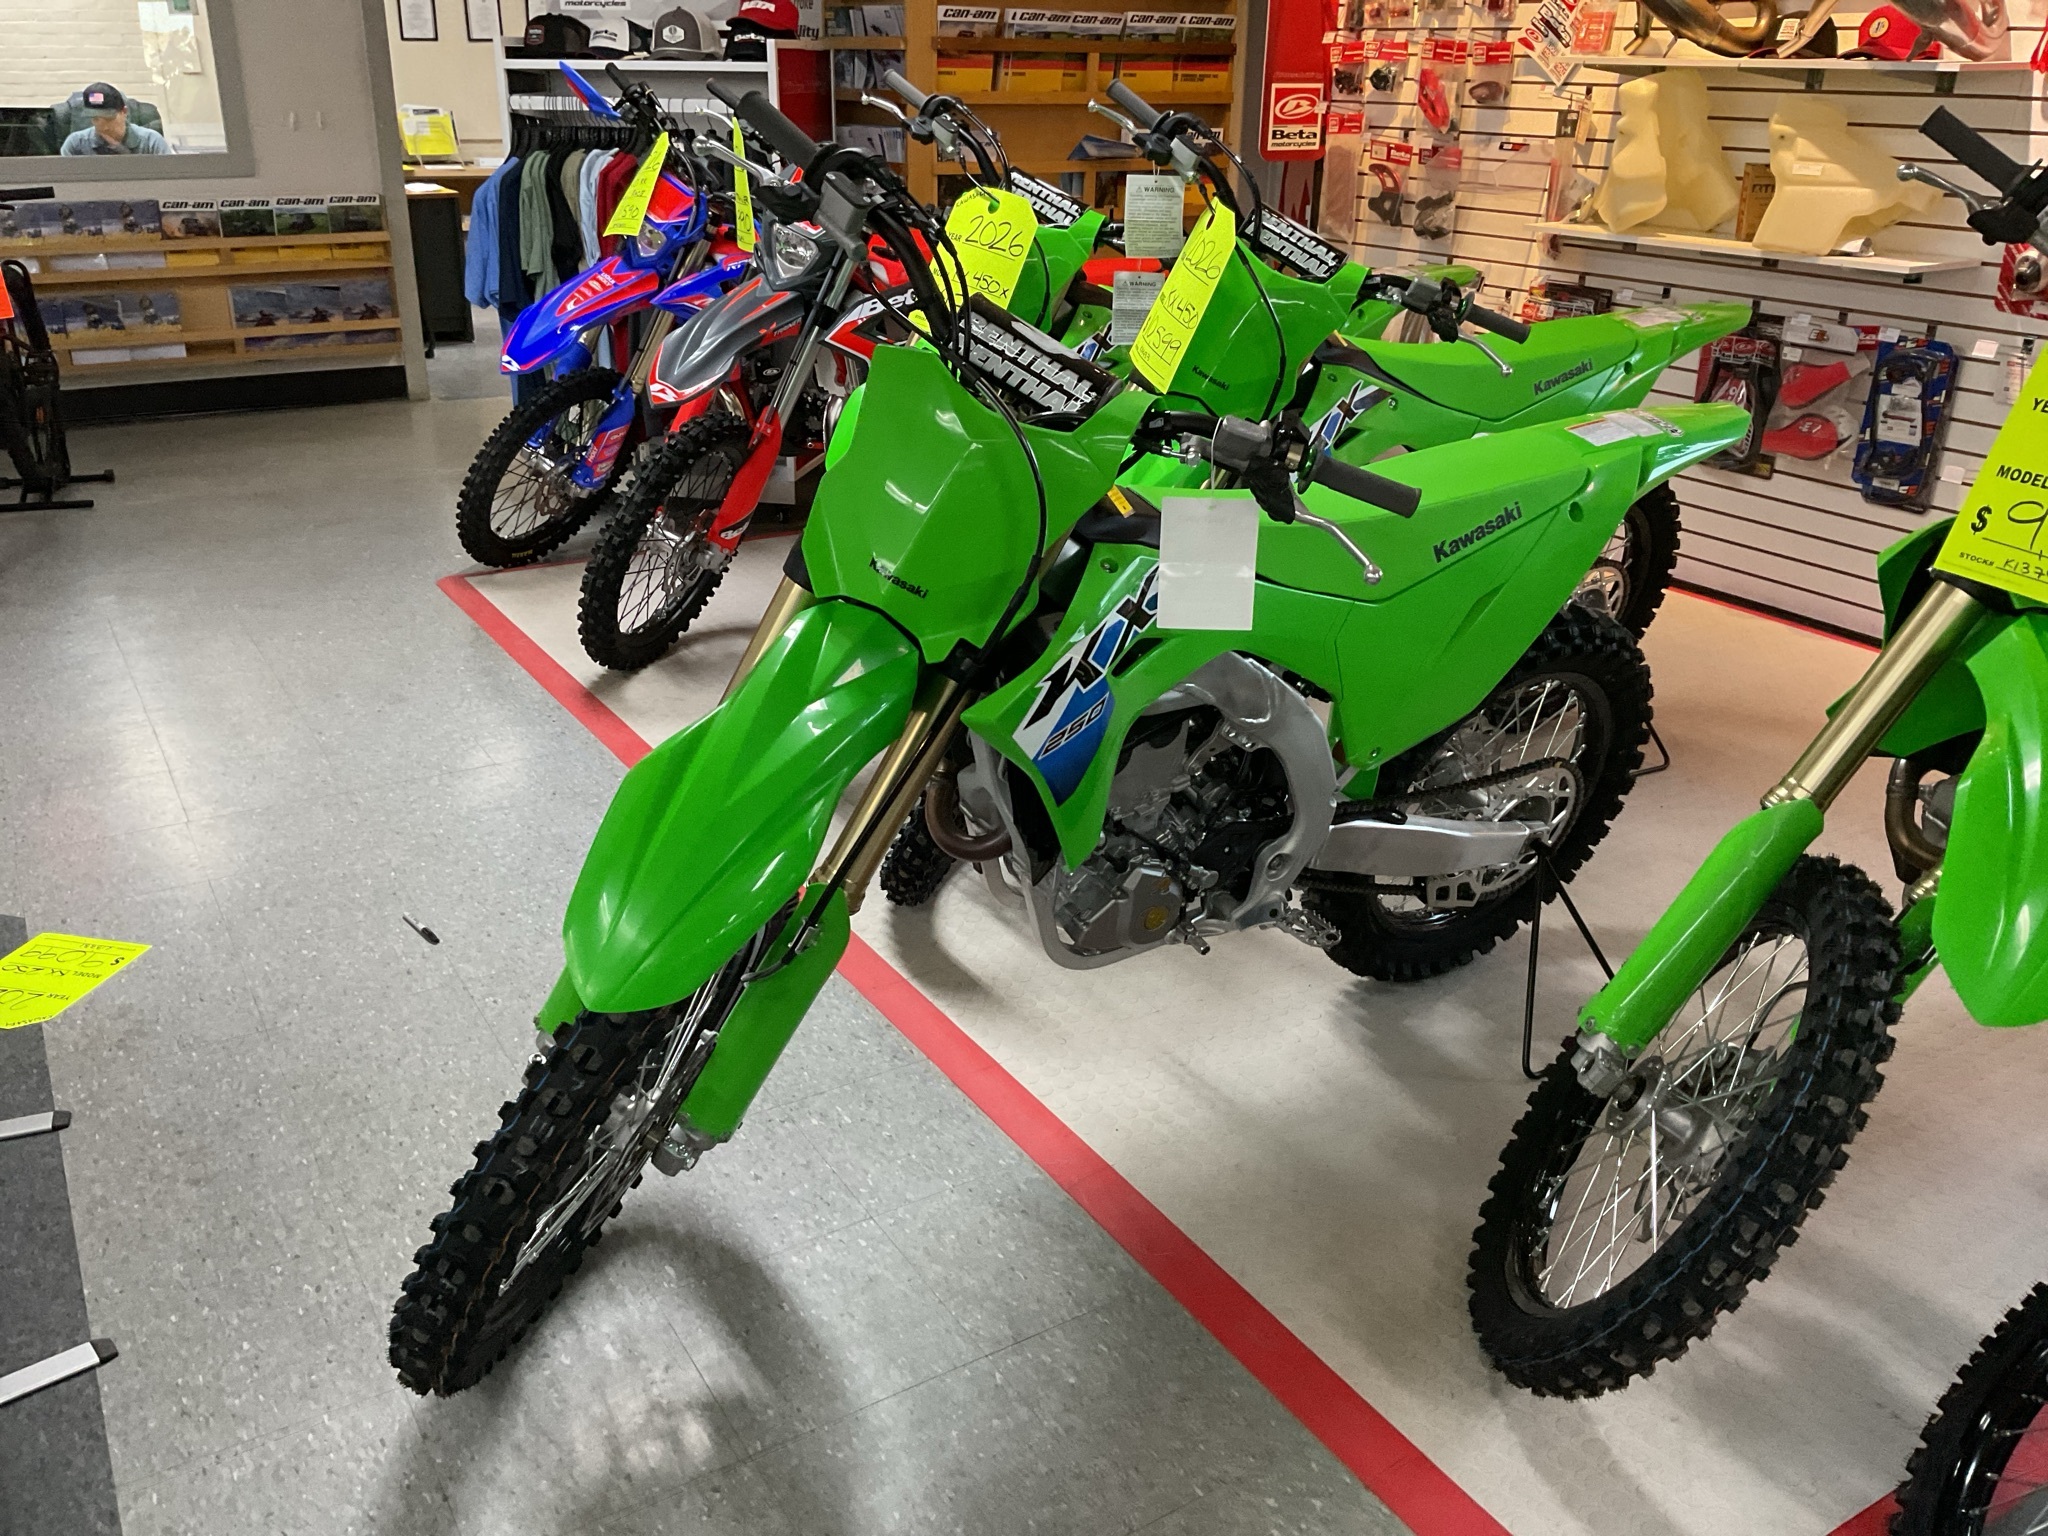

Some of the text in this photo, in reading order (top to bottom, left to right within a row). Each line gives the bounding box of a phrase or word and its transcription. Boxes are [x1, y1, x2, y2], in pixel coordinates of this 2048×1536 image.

[943, 8, 997, 20] can-am
[1019, 11, 1072, 24] can-am
[1072, 14, 1123, 26] can-am
[1130, 14, 1178, 25] can-am
[1189, 15, 1235, 27] can-am
[1272, 129, 1318, 140] Beta
[163, 200, 215, 210] can-am
[220, 199, 270, 208] can-am
[276, 197, 325, 206] can-am
[329, 195, 377, 204] can-am
[948, 215, 1024, 257] YEAR 2026
[1191, 364, 1230, 391] Kawasaki
[1534, 357, 1594, 396] Kawasaki
[1970, 504, 1993, 536] $
[1433, 501, 1523, 564] Kawasaki
[1038, 692, 1110, 761] 250
[72, 970, 103, 979] MODEL
[46, 993, 70, 1001] YEAR
